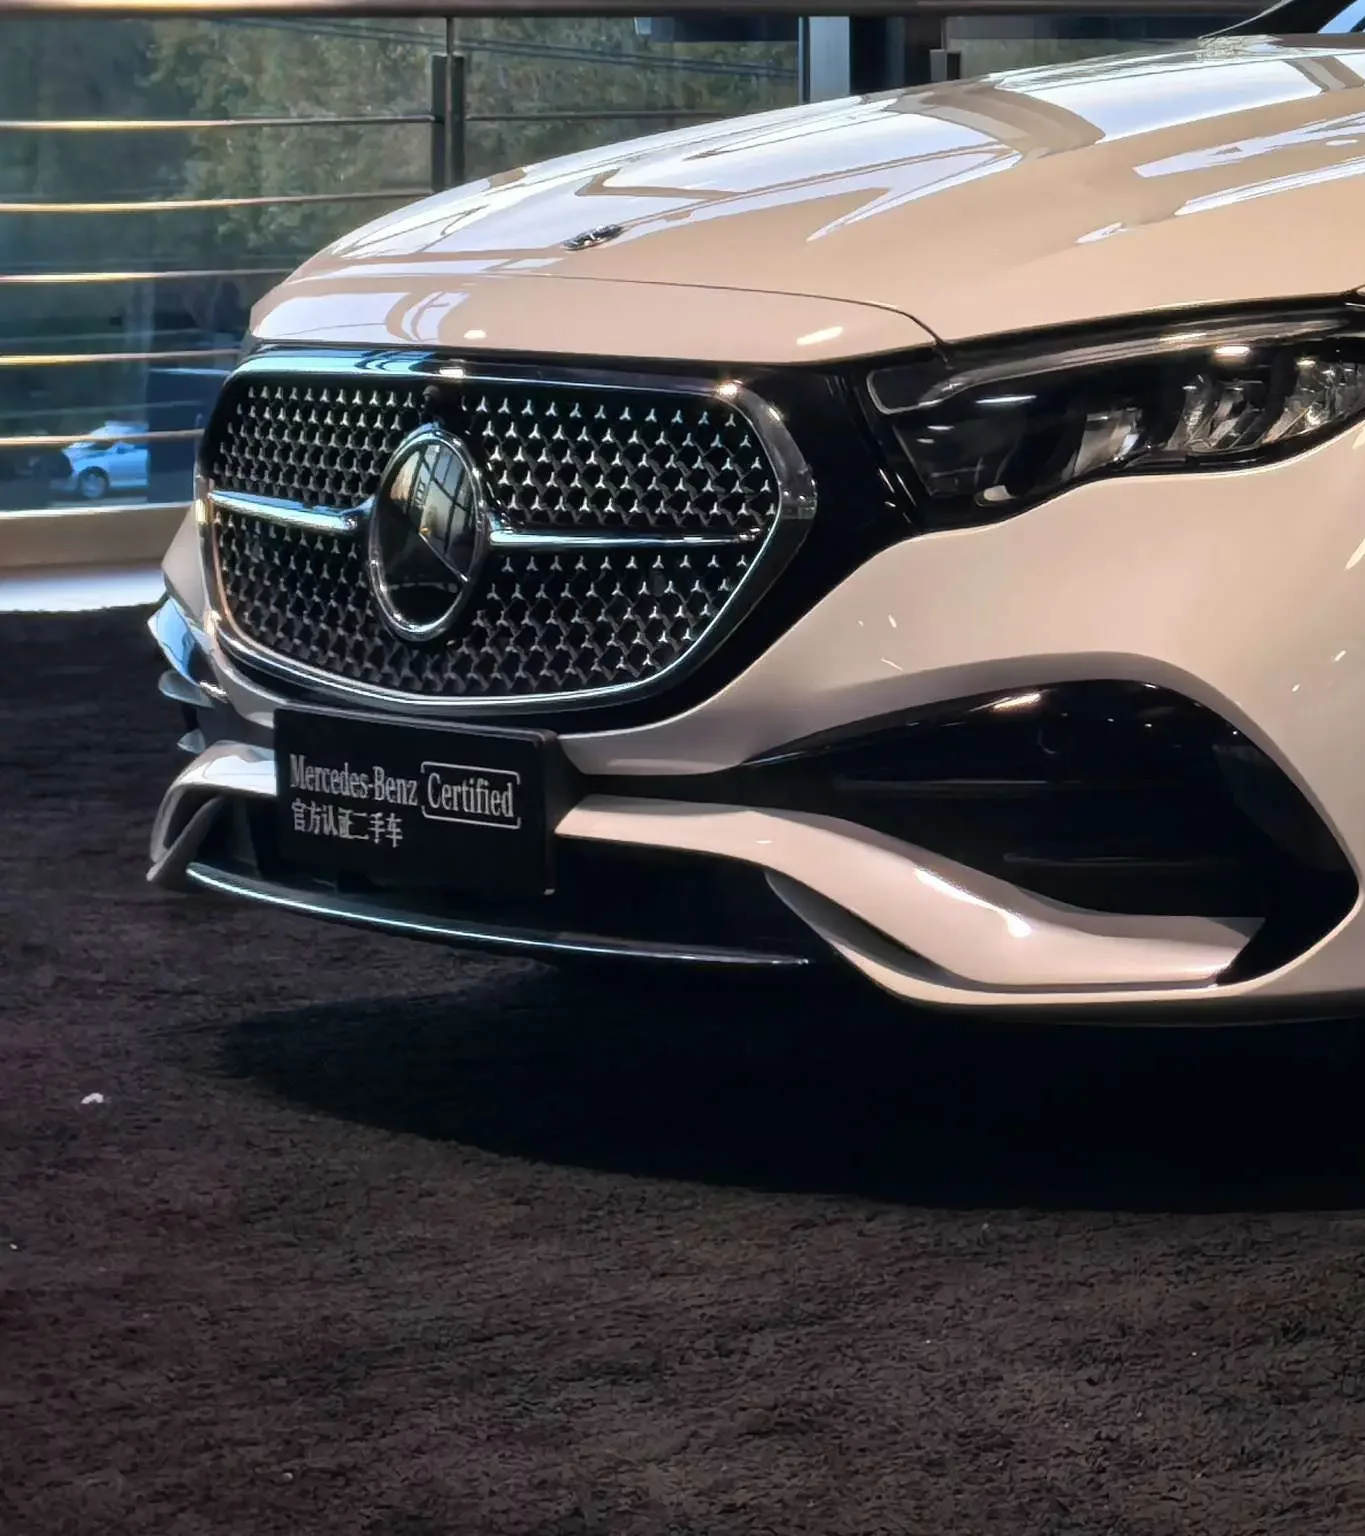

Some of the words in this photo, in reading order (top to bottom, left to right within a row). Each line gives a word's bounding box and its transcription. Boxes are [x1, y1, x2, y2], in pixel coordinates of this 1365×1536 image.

[290, 753, 418, 806] Mercedes-Benz
[427, 772, 515, 818] Certified
[291, 798, 403, 849] 官方认证二手车
